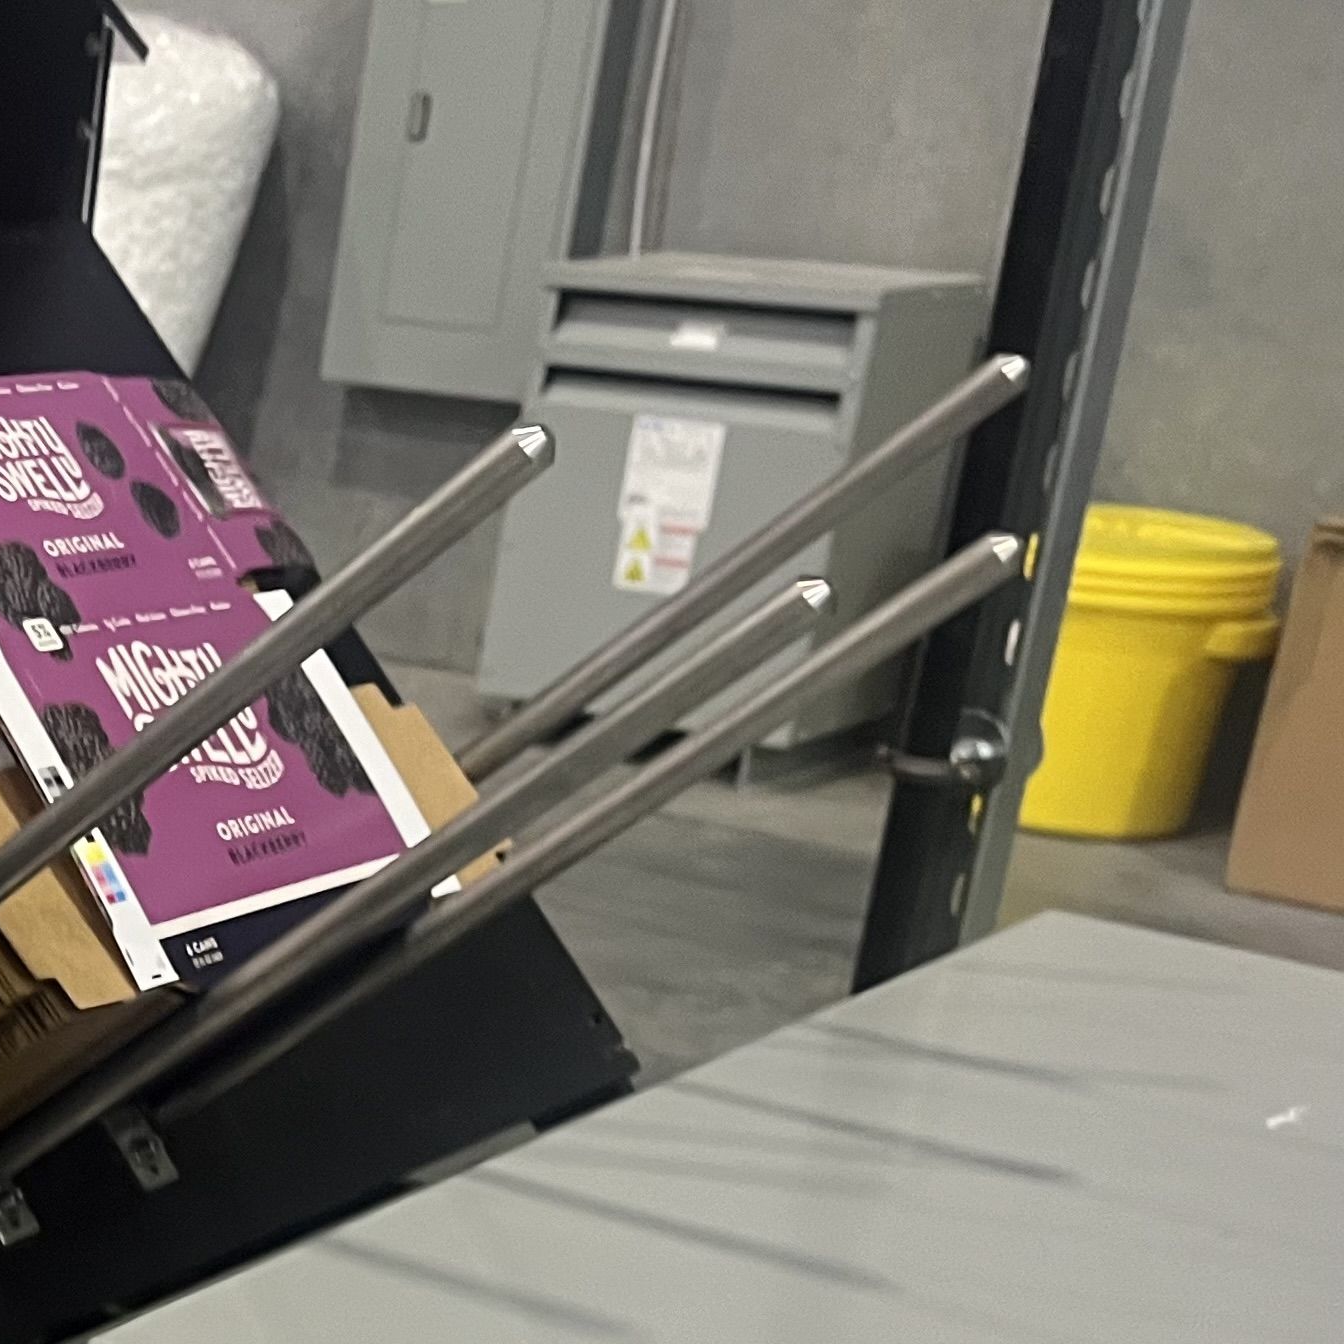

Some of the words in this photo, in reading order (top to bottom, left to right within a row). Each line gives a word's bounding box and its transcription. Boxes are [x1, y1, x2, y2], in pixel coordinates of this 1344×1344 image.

[42, 531, 125, 557] ORIGINAL
[95, 641, 223, 720] MIGHTY
[215, 806, 296, 841] ORIGINAL
